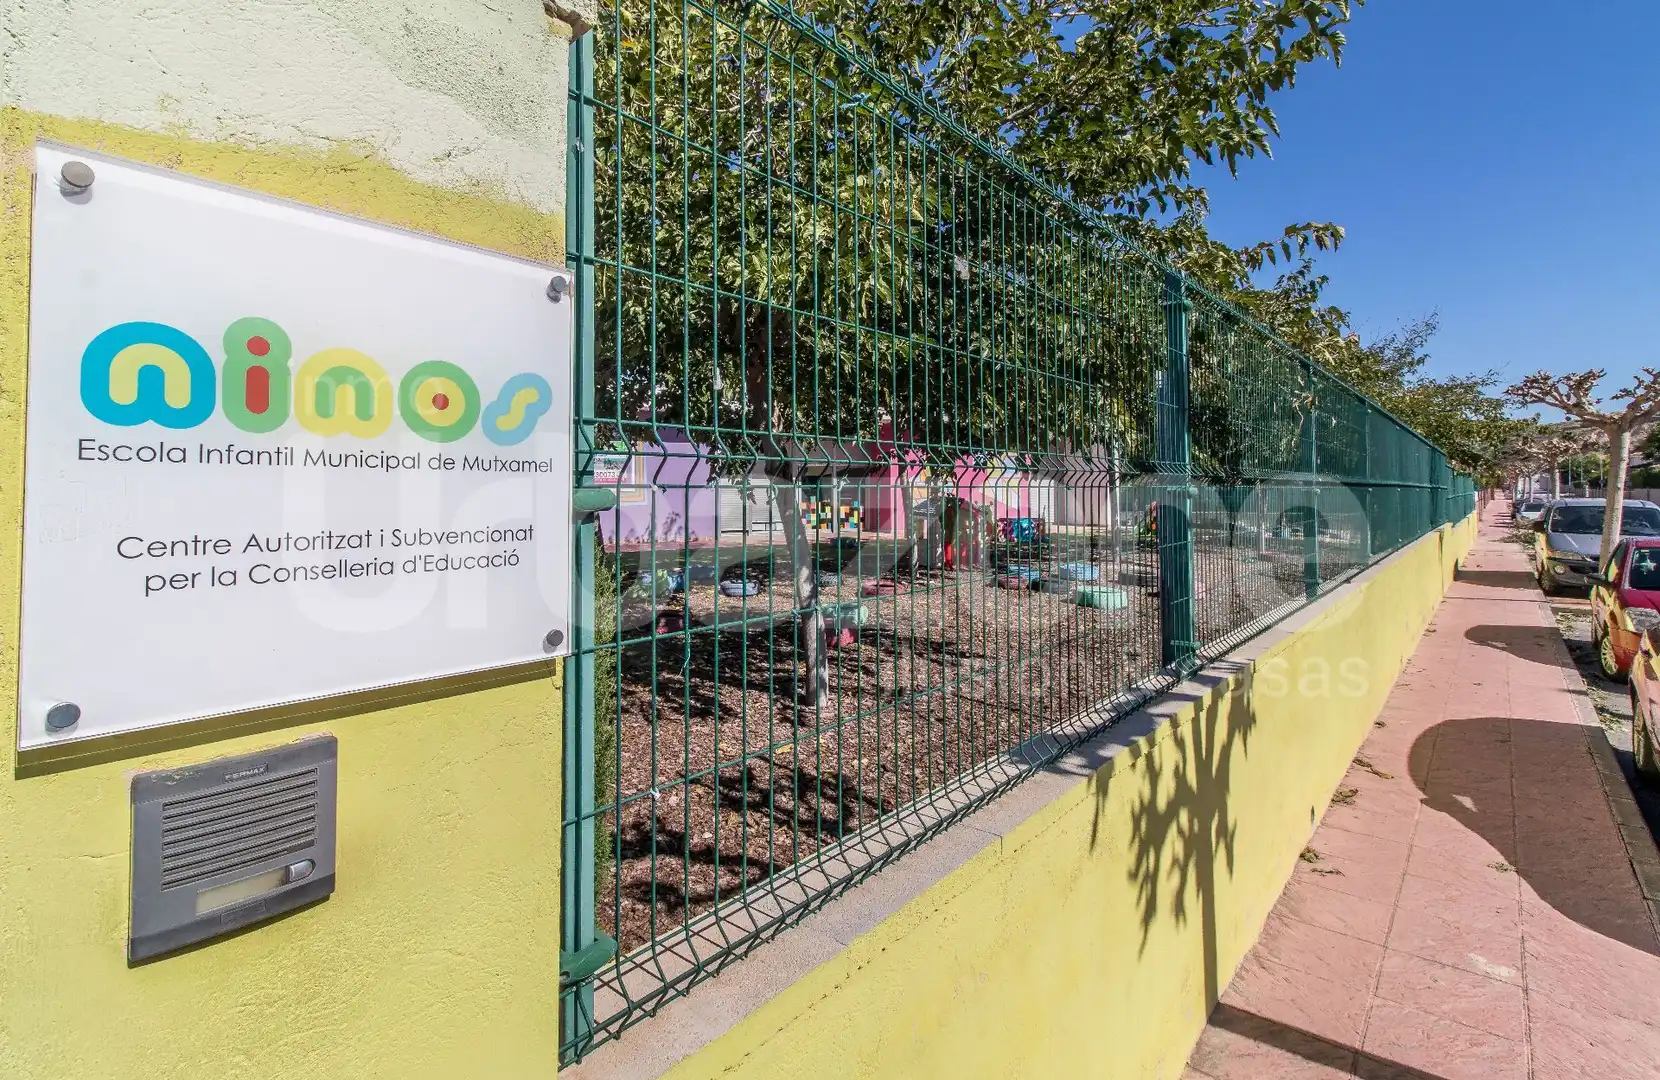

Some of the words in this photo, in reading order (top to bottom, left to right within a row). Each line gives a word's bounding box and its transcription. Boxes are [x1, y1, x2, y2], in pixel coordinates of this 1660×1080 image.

[78, 438, 187, 464] Escola
[199, 443, 294, 467] Infantil
[303, 448, 421, 473] Municipal
[428, 453, 456, 471] de
[462, 455, 553, 473] Mutxamel
[116, 535, 232, 560] Centre
[243, 529, 373, 554] Autoritzat
[379, 528, 384, 547] i
[391, 524, 534, 548] Subvencionat
[145, 572, 201, 597] per
[211, 565, 237, 588] la
[248, 557, 394, 585] Conselleria
[402, 549, 520, 574] d'Educació
